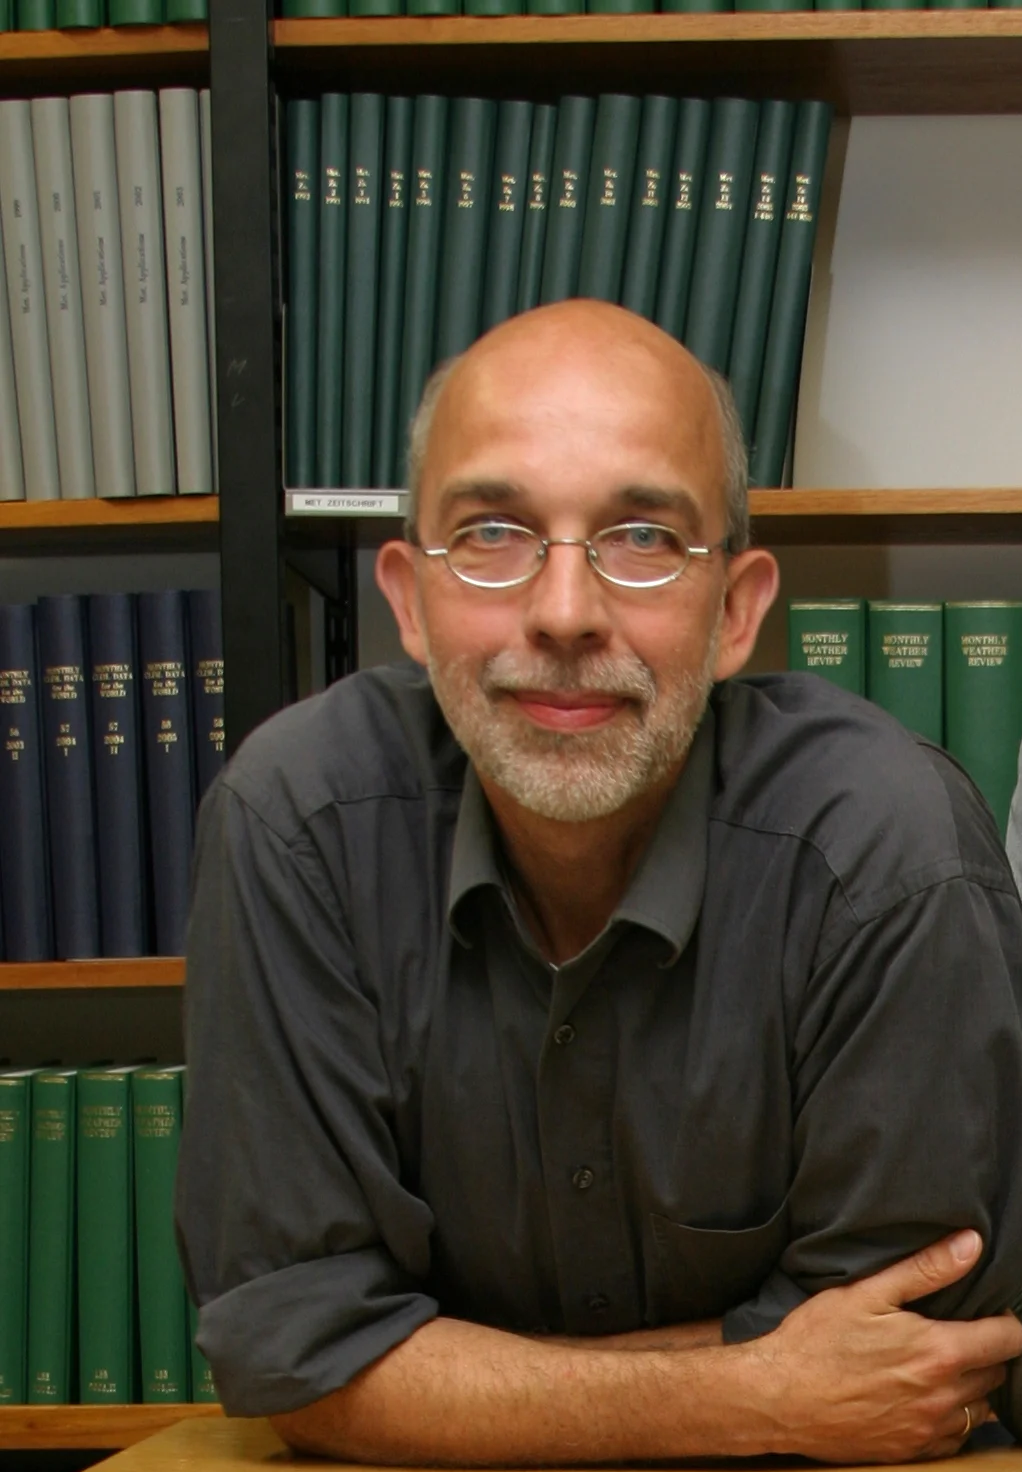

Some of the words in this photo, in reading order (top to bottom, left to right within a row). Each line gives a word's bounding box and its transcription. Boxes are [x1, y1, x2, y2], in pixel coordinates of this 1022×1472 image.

[802, 632, 849, 643] MONTHLY
[883, 634, 929, 645] MONTHLY
[961, 635, 1007, 645] MONTHLY
[803, 645, 848, 655] WEATHER
[882, 646, 928, 656] WEATHER
[962, 646, 1007, 656] WEATHER
[199, 661, 225, 669] MONTH
[807, 656, 843, 666] REVIEW
[888, 658, 924, 668] REVIEW
[968, 657, 1004, 667] REVIEW
